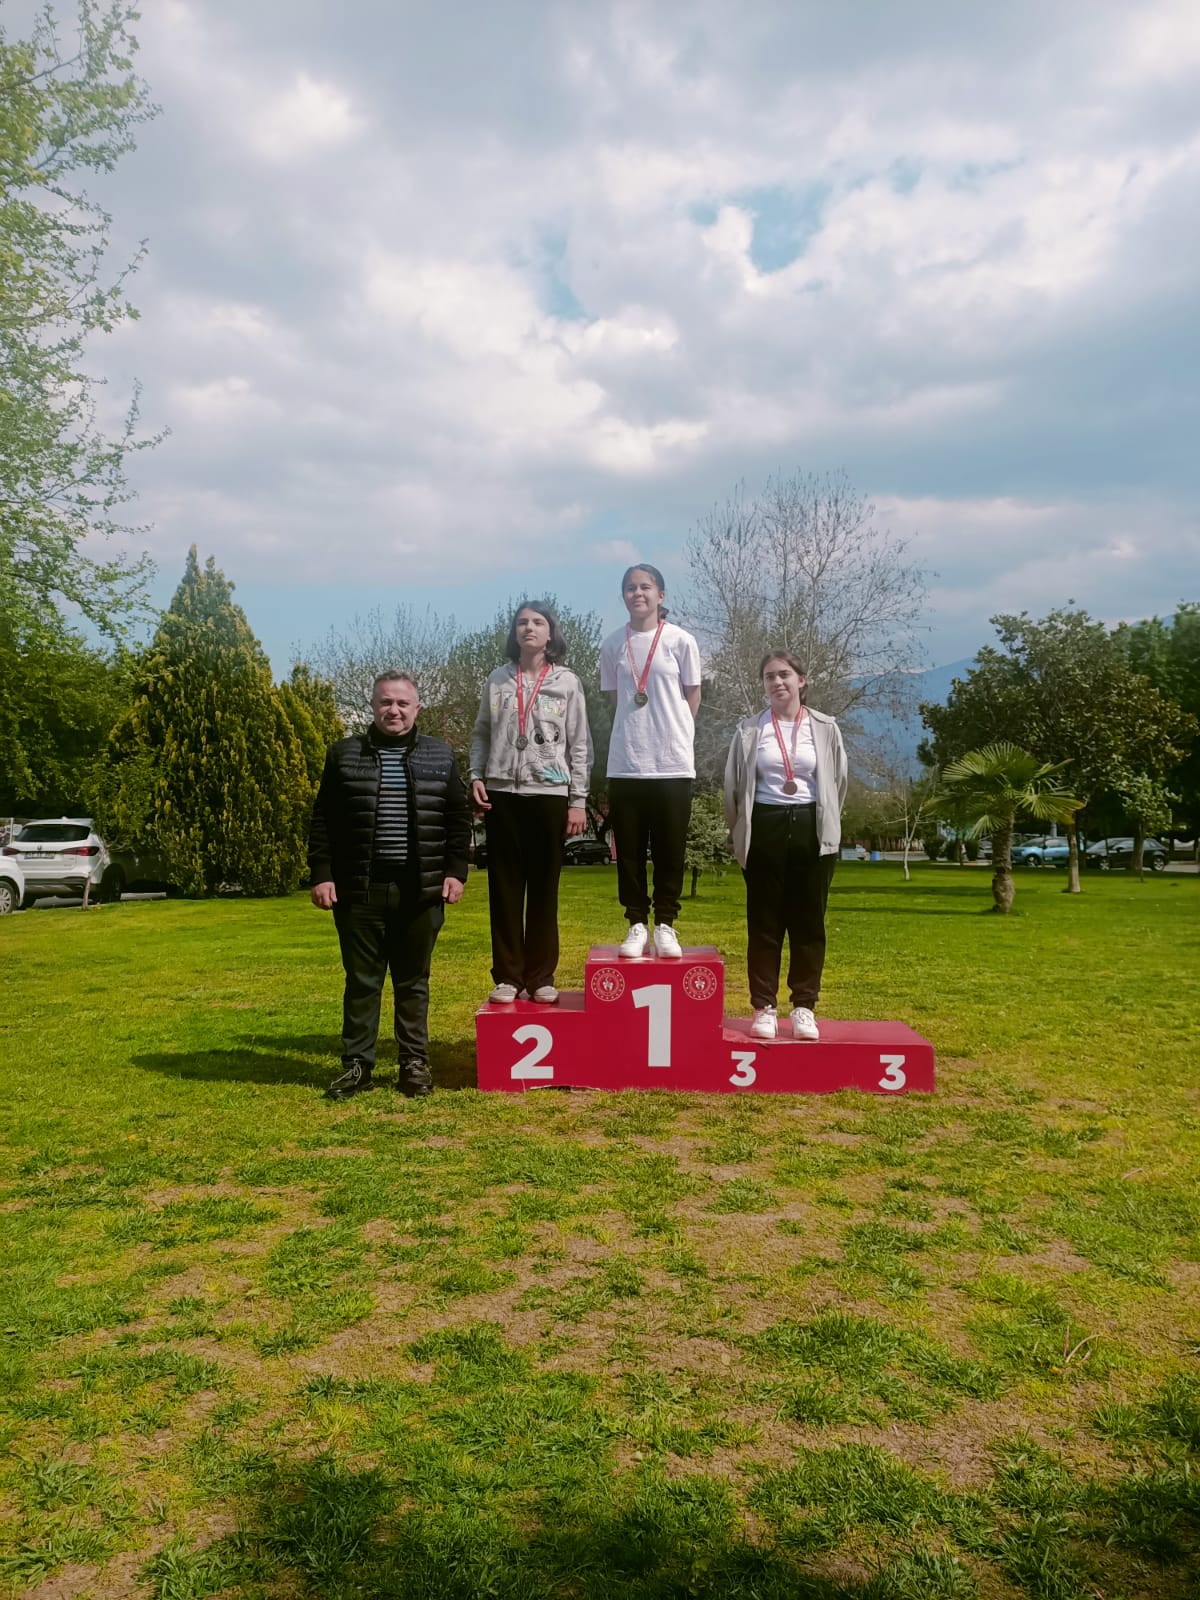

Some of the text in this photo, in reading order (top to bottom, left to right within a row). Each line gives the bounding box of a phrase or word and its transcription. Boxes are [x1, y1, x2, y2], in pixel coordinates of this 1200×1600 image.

[632, 984, 672, 1067] 1
[510, 1024, 554, 1080] 2
[729, 1051, 757, 1087] 3
[878, 1054, 906, 1091] 3
